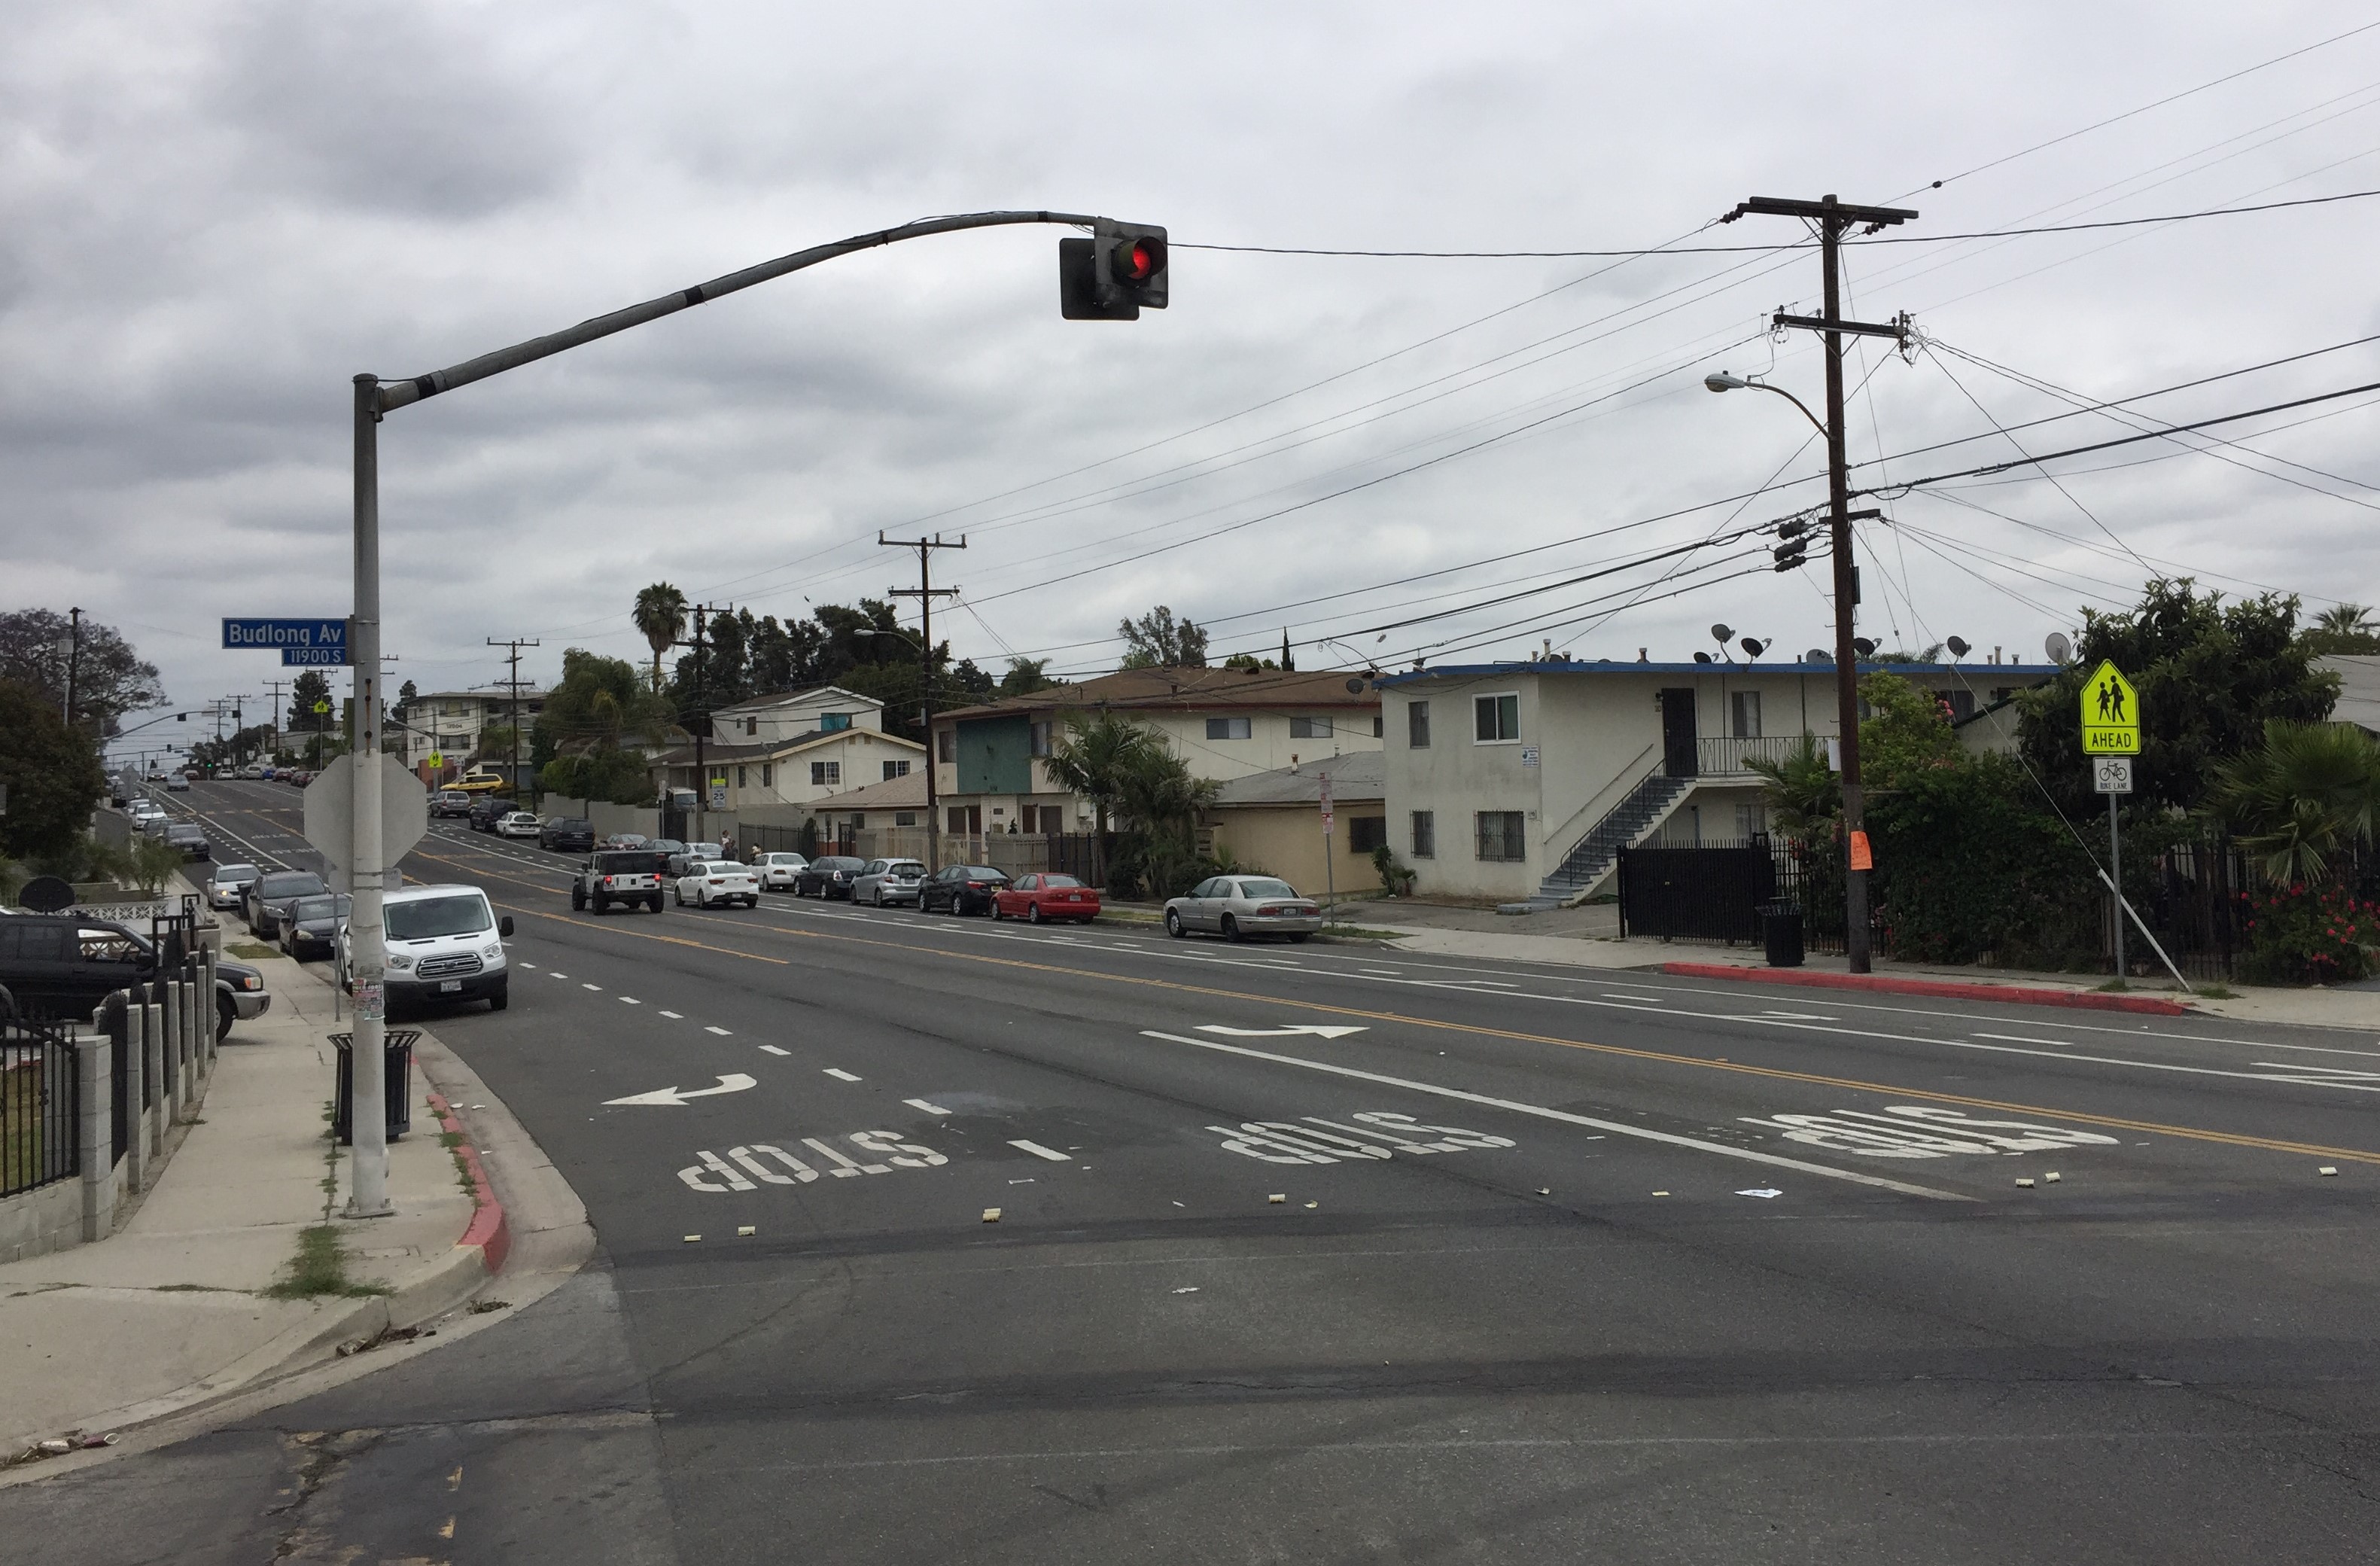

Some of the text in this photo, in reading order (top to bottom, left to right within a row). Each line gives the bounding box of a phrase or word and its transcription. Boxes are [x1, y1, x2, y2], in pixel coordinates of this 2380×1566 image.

[229, 623, 342, 647] Budlong Av
[291, 650, 342, 663] 11900 S
[2091, 732, 2132, 748] AHEAD
[1203, 1111, 1517, 1165] STOP
[1735, 1105, 2122, 1159] STOP
[676, 1130, 950, 1193] STOP
